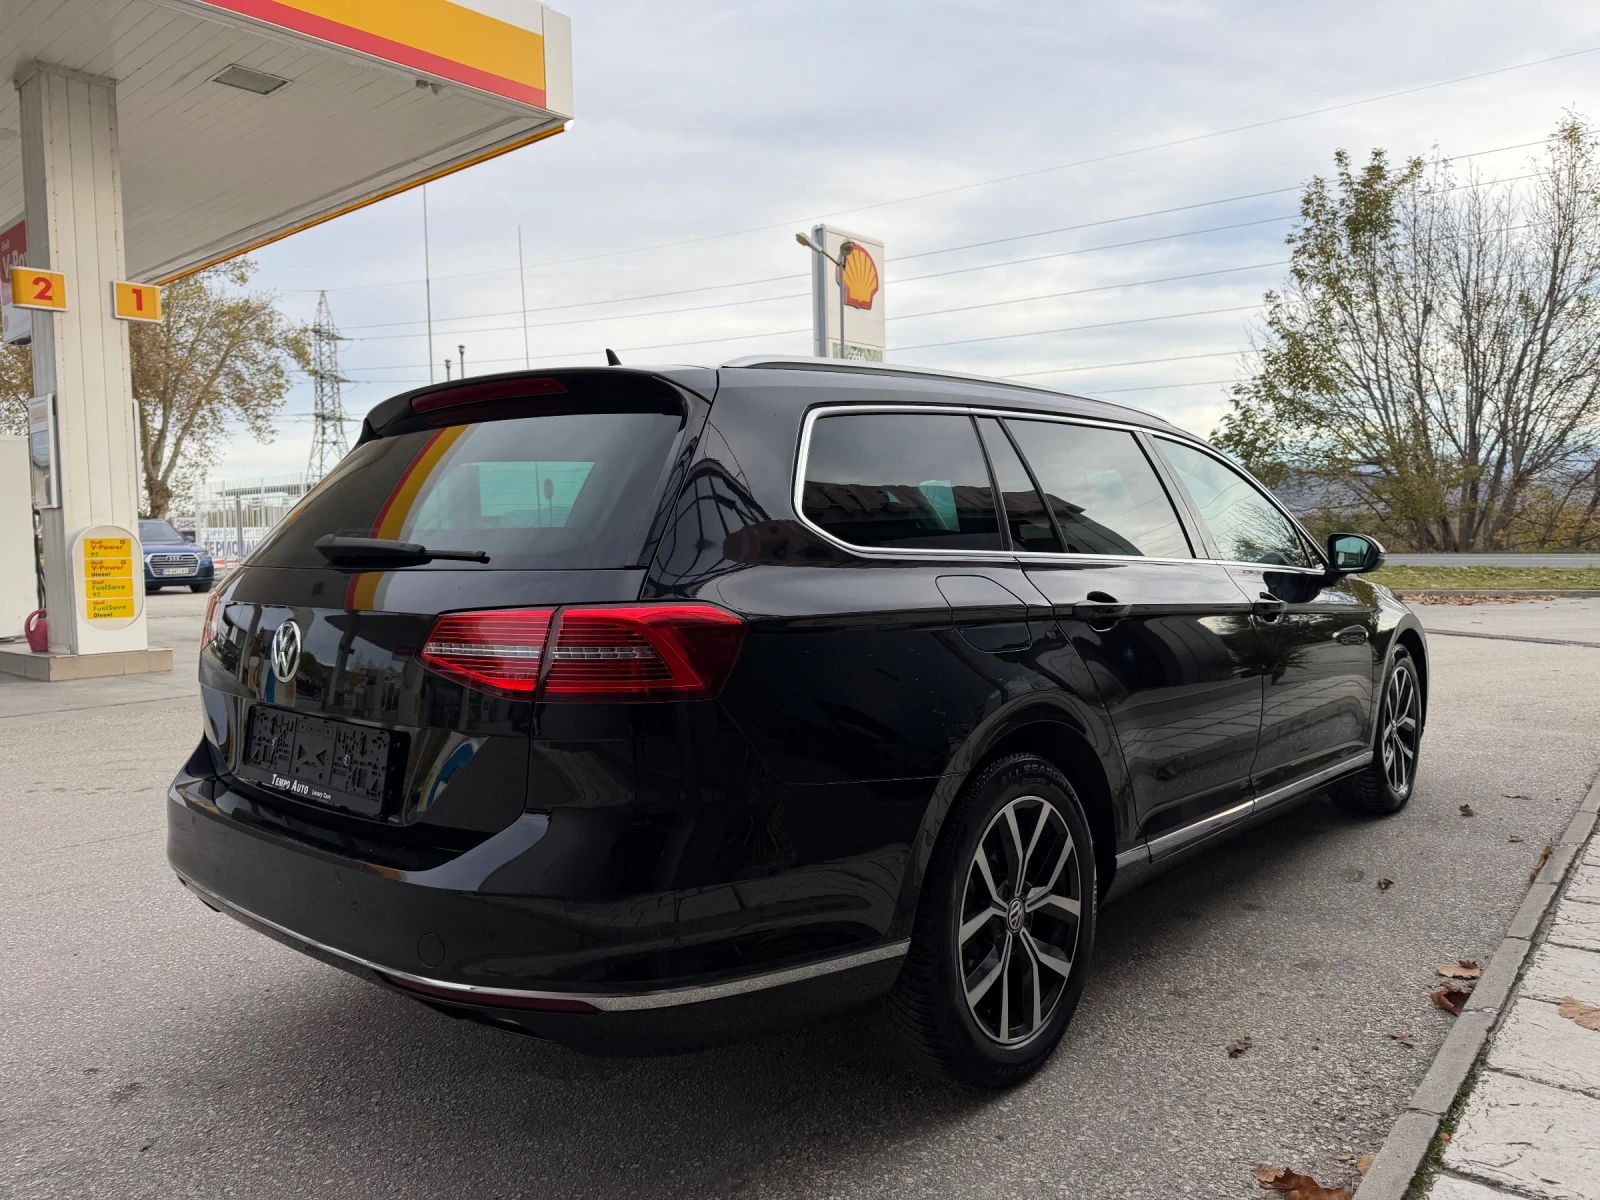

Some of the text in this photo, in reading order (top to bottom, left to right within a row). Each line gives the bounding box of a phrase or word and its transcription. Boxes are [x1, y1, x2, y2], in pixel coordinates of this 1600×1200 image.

[32, 276, 53, 301] 2
[131, 288, 143, 311] 1
[291, 780, 309, 795] AUTO
